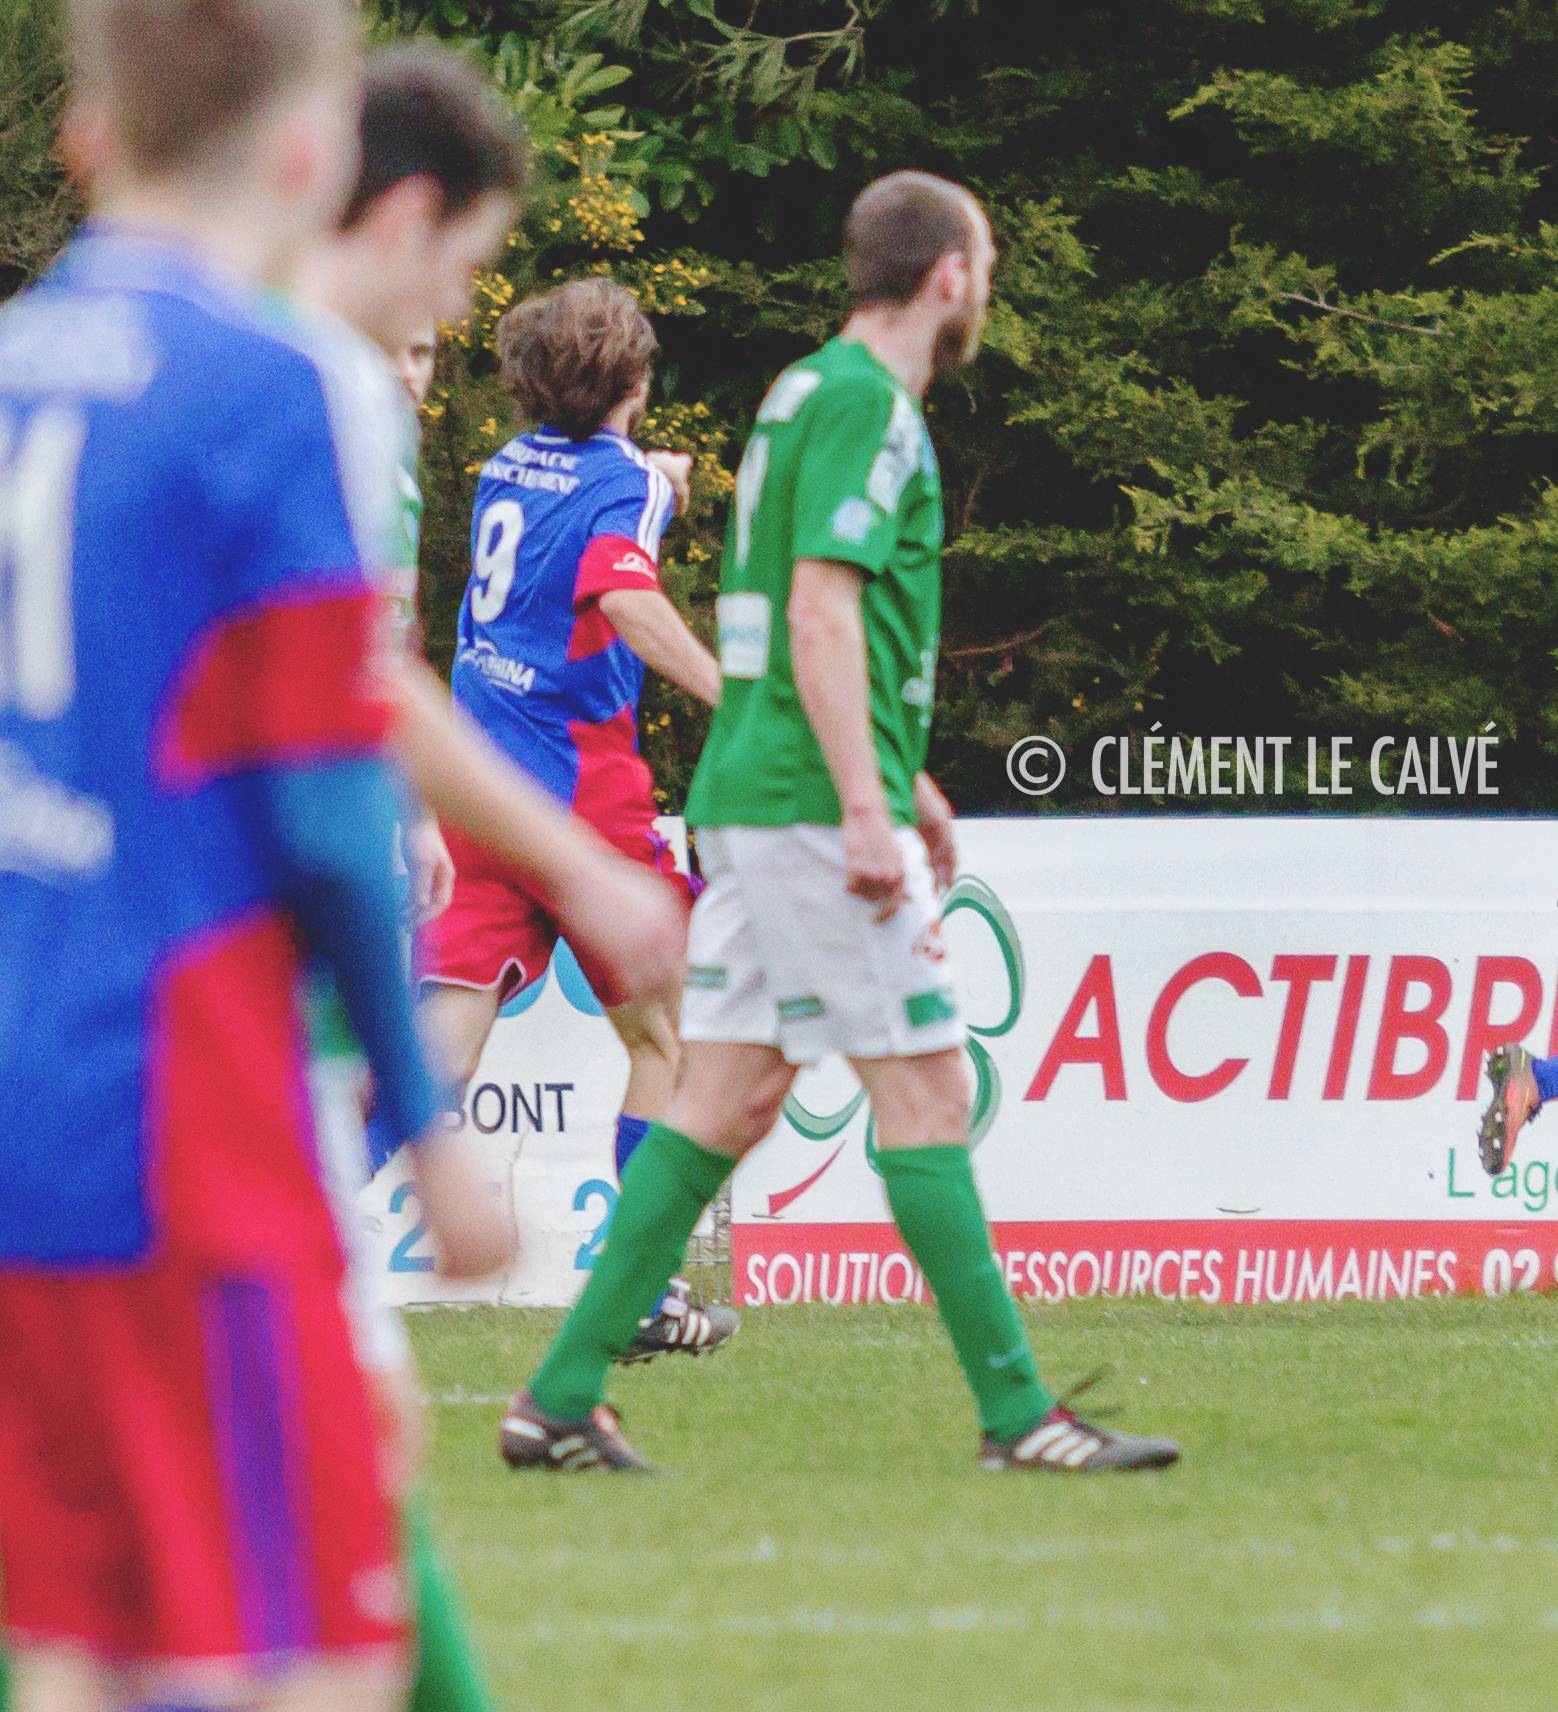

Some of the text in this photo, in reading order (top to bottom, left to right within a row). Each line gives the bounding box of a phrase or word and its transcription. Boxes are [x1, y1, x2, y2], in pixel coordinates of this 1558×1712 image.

[471, 500, 524, 624] 9
[990, 1248, 1224, 1306] ESSOURCES
[1234, 1247, 1458, 1304] HUMAINES
[1482, 1247, 1540, 1299] 02
